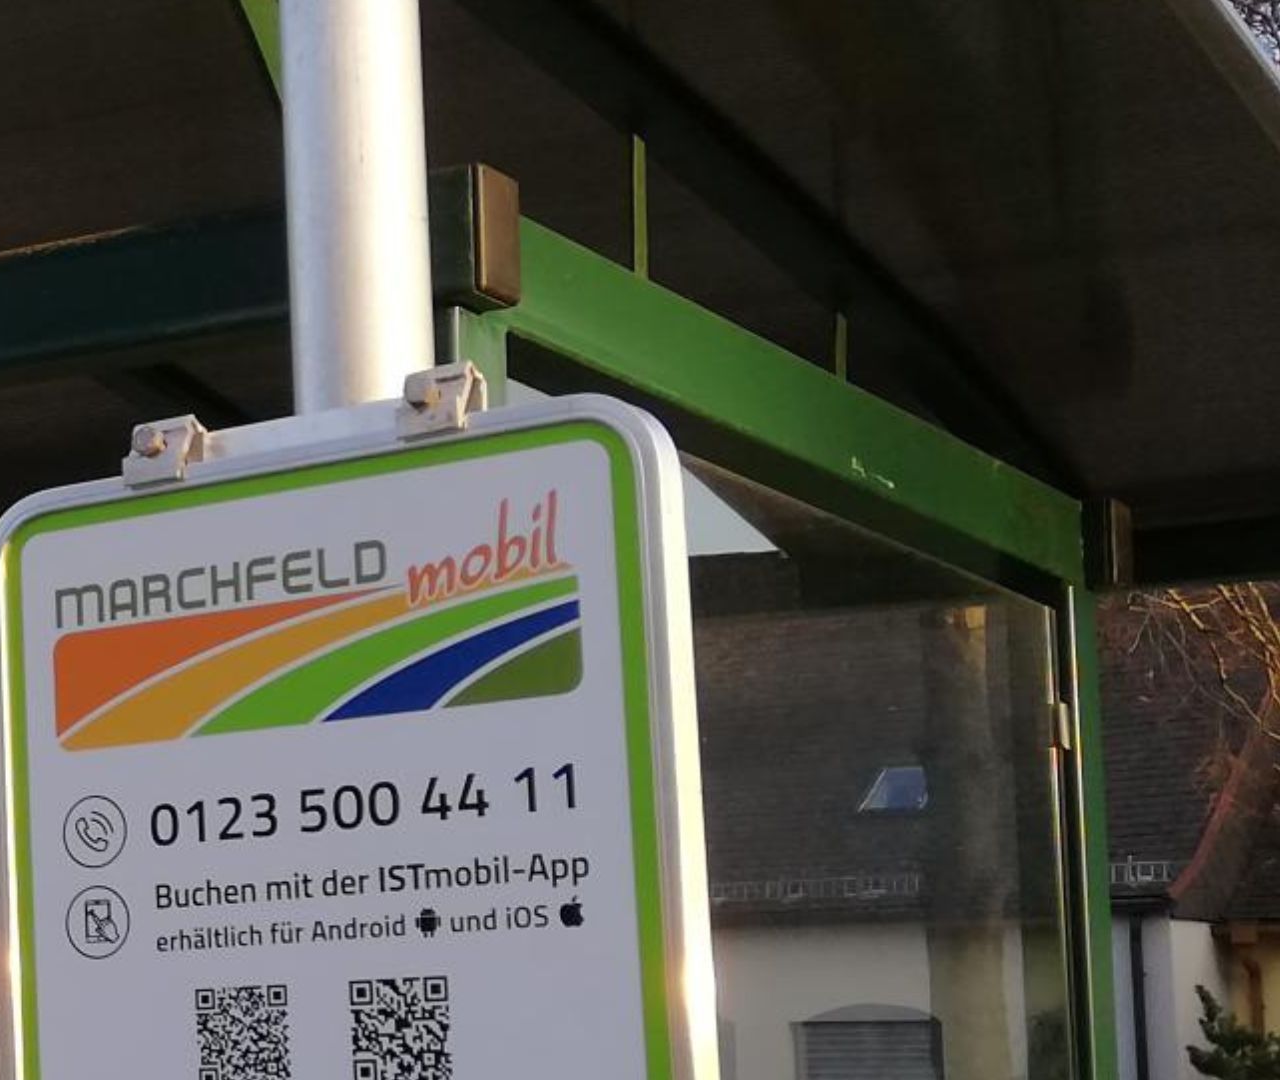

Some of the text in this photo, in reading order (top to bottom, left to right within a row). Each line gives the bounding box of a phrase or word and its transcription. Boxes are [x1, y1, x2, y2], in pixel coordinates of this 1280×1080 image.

[54, 488, 559, 629] MARCHFELD mobil
[150, 762, 578, 847] 0123 500 44 11
[155, 853, 590, 910] Buchen mit der ISTmobil-App
[156, 905, 549, 952] erhältlich für Android und iOS
